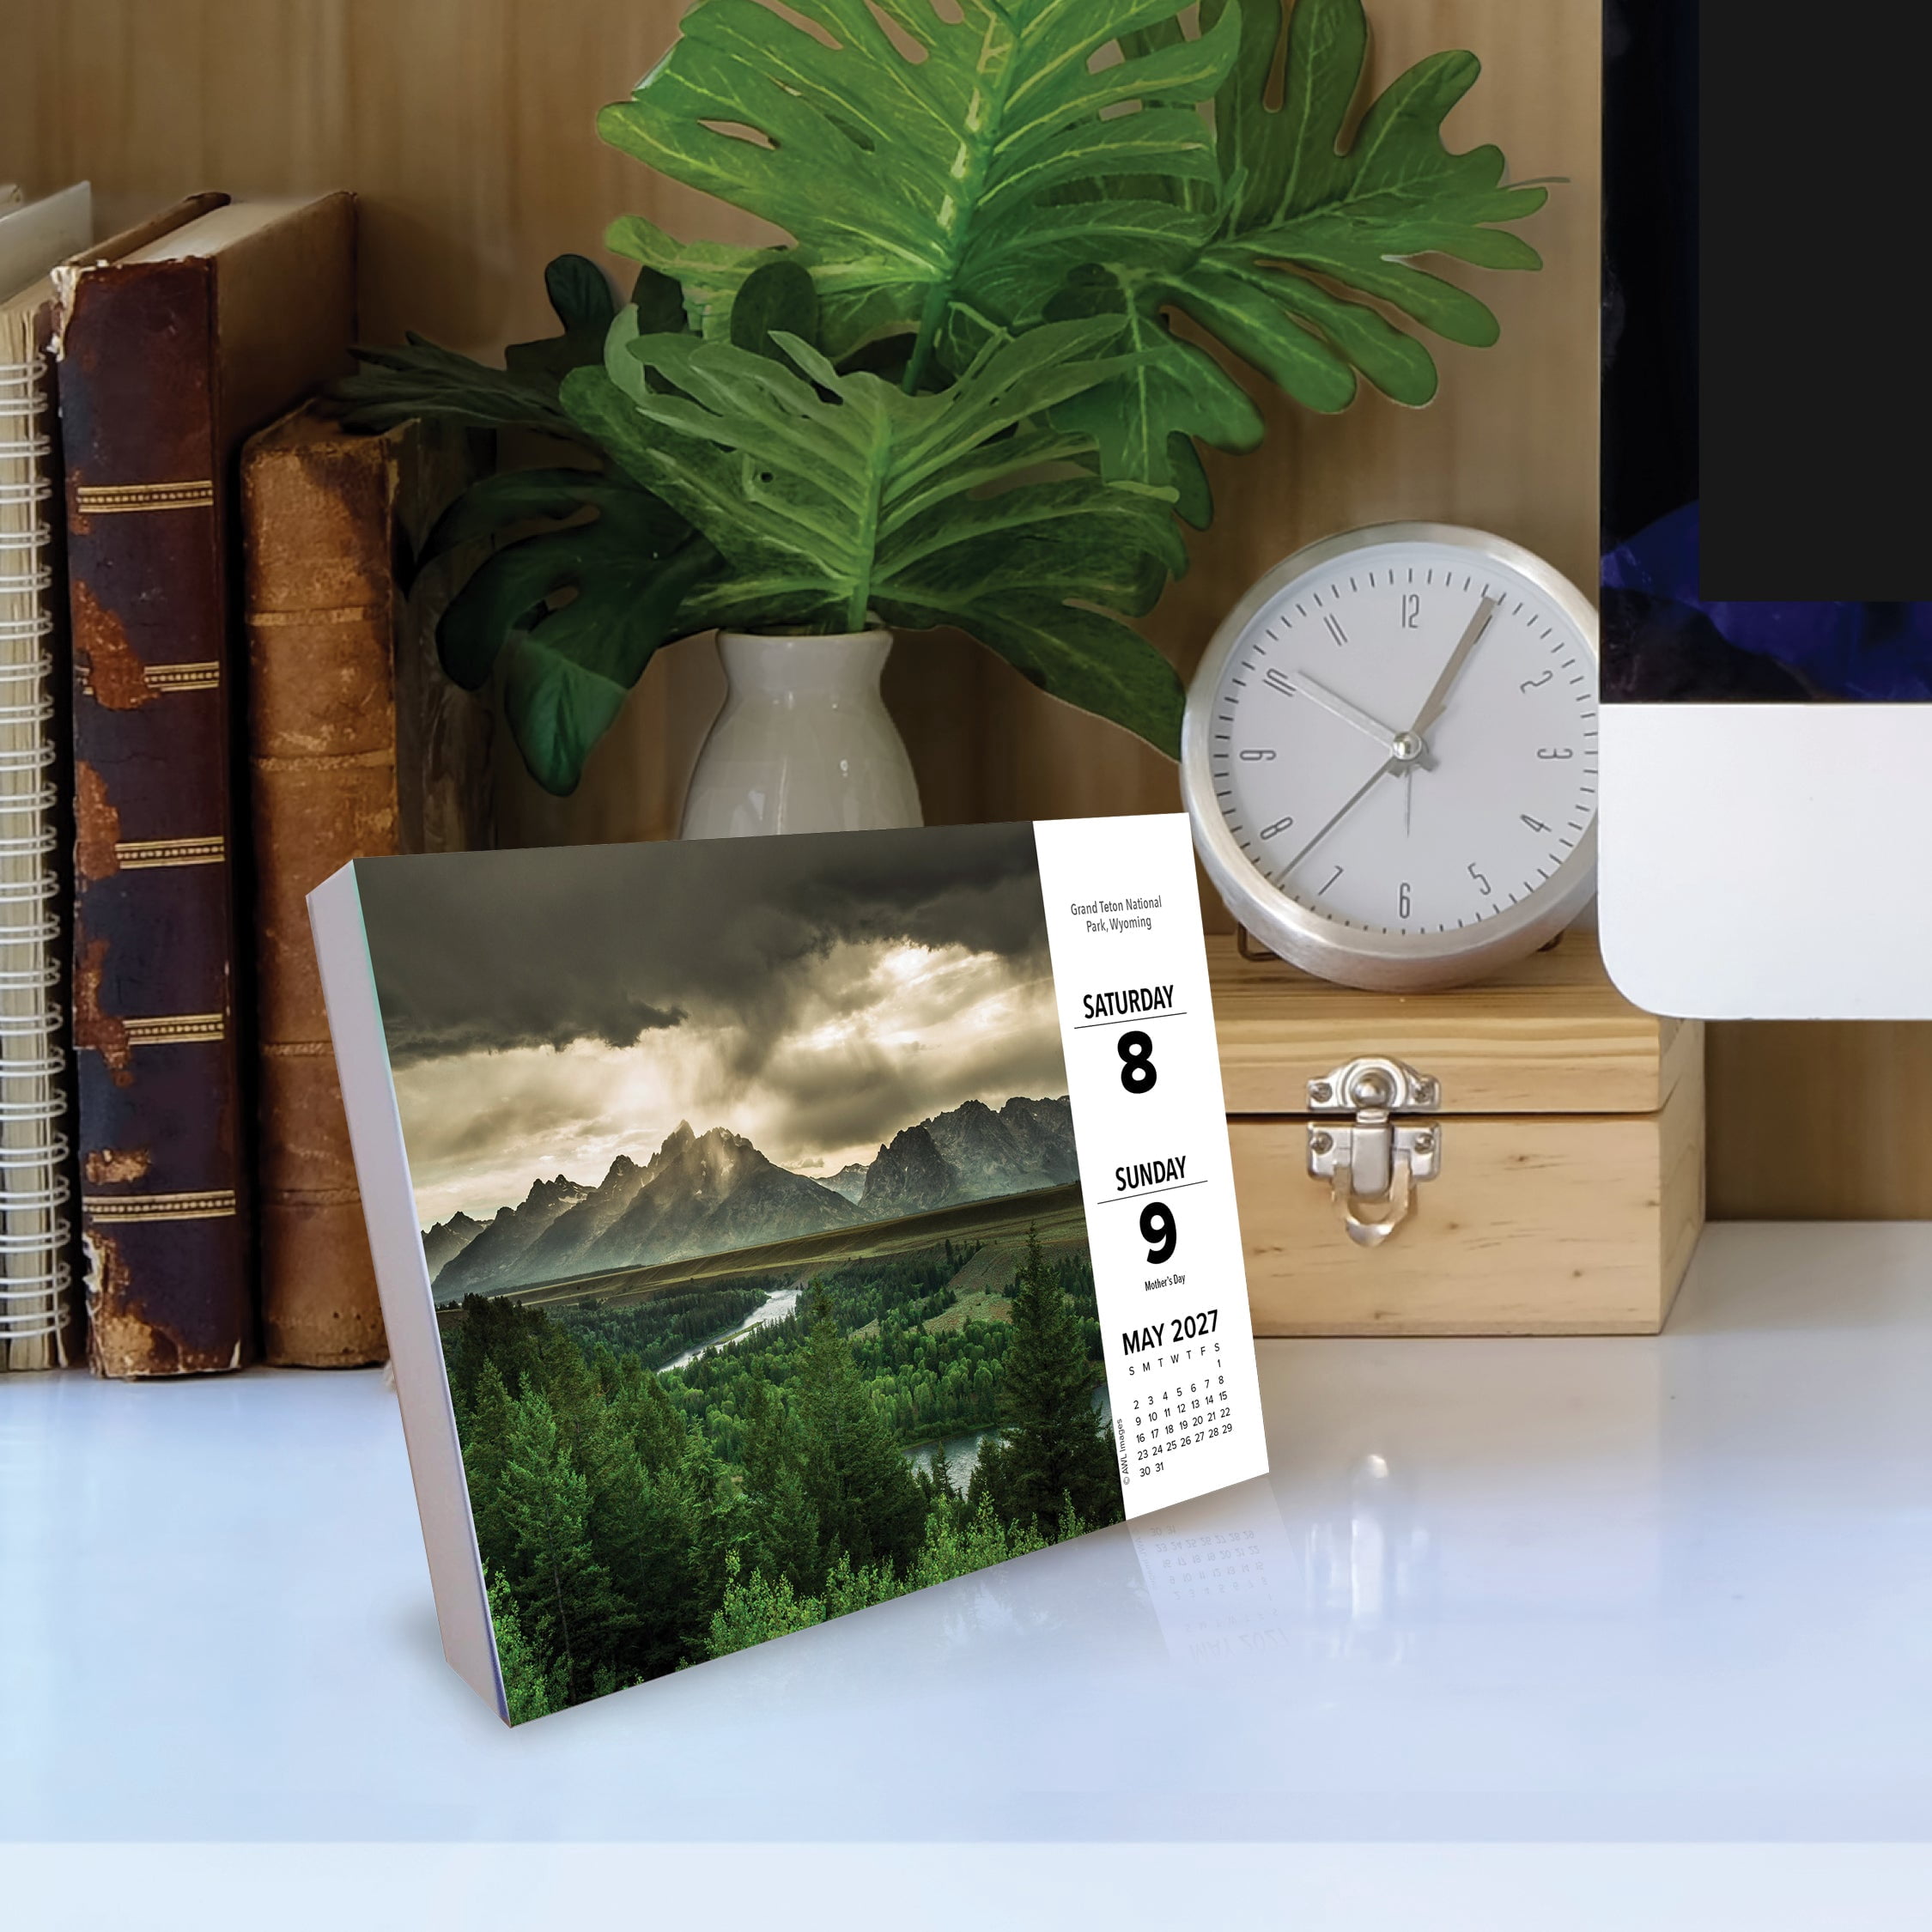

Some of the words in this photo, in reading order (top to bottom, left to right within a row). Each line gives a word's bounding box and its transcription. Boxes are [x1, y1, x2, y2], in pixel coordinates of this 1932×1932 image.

[1401, 594, 1419, 629] 12
[1323, 614, 1348, 647] 11
[1262, 668, 1297, 697] 10
[1520, 670, 1553, 694] 2
[1240, 749, 1277, 761] 9
[1537, 748, 1573, 760] 3
[1261, 817, 1294, 841] 8
[1521, 814, 1552, 833] 4
[1318, 866, 1344, 896] 7
[1467, 863, 1492, 896] 5
[1070, 901, 1098, 916] Grand
[1098, 900, 1124, 914] Teton
[1125, 895, 1163, 911] National
[1399, 882, 1411, 920] 6
[1085, 917, 1109, 933] Park,
[1109, 917, 1152, 933] Wyoming
[1083, 984, 1174, 1019] SATURDAY
[1117, 1030, 1157, 1094] 8
[1115, 1155, 1187, 1192] SUNDAY
[1139, 1201, 1177, 1265] 9
[1173, 1273, 1186, 1285] Day
[1121, 1322, 1165, 1356] MAY
[1170, 1309, 1218, 1343] 2027
[1128, 1366, 1135, 1376] S
[1142, 1361, 1151, 1372] M
[1157, 1358, 1163, 1368] T
[1170, 1353, 1180, 1364] W
[1185, 1350, 1192, 1359] T
[1200, 1346, 1206, 1356] F
[1213, 1342, 1220, 1352] S
[1133, 1400, 1140, 1410] 2
[1147, 1395, 1154, 1406] 3
[1162, 1391, 1169, 1400] 4
[1176, 1387, 1183, 1397] 5
[1190, 1383, 1197, 1393] 6
[1204, 1378, 1210, 1388] 7
[1218, 1375, 1224, 1385] 8
[1135, 1416, 1142, 1426] 9
[1148, 1412, 1158, 1423] 10
[1163, 1407, 1171, 1418] 11
[1176, 1403, 1187, 1414] 12
[1191, 1399, 1200, 1410] 13
[1205, 1394, 1214, 1406] 14
[1218, 1390, 1228, 1401] 15
[1117, 1418, 1127, 1453] Images
[1135, 1432, 1145, 1443] 16
[1151, 1428, 1159, 1439] 17
[1164, 1424, 1175, 1435] 18
[1179, 1420, 1188, 1431] 19
[1192, 1416, 1204, 1427] 20
[1206, 1411, 1217, 1423] 21
[1219, 1406, 1231, 1419] 22
[1137, 1449, 1149, 1461] 23
[1151, 1444, 1163, 1456] 24
[1165, 1439, 1177, 1452] 25
[1180, 1435, 1192, 1448] 26
[1194, 1431, 1205, 1443] 27
[1208, 1427, 1219, 1439] 28
[1221, 1423, 1233, 1435] 29
[1121, 1453, 1129, 1475] AWL
[1139, 1466, 1151, 1478] 30
[1154, 1461, 1164, 1473] 31
